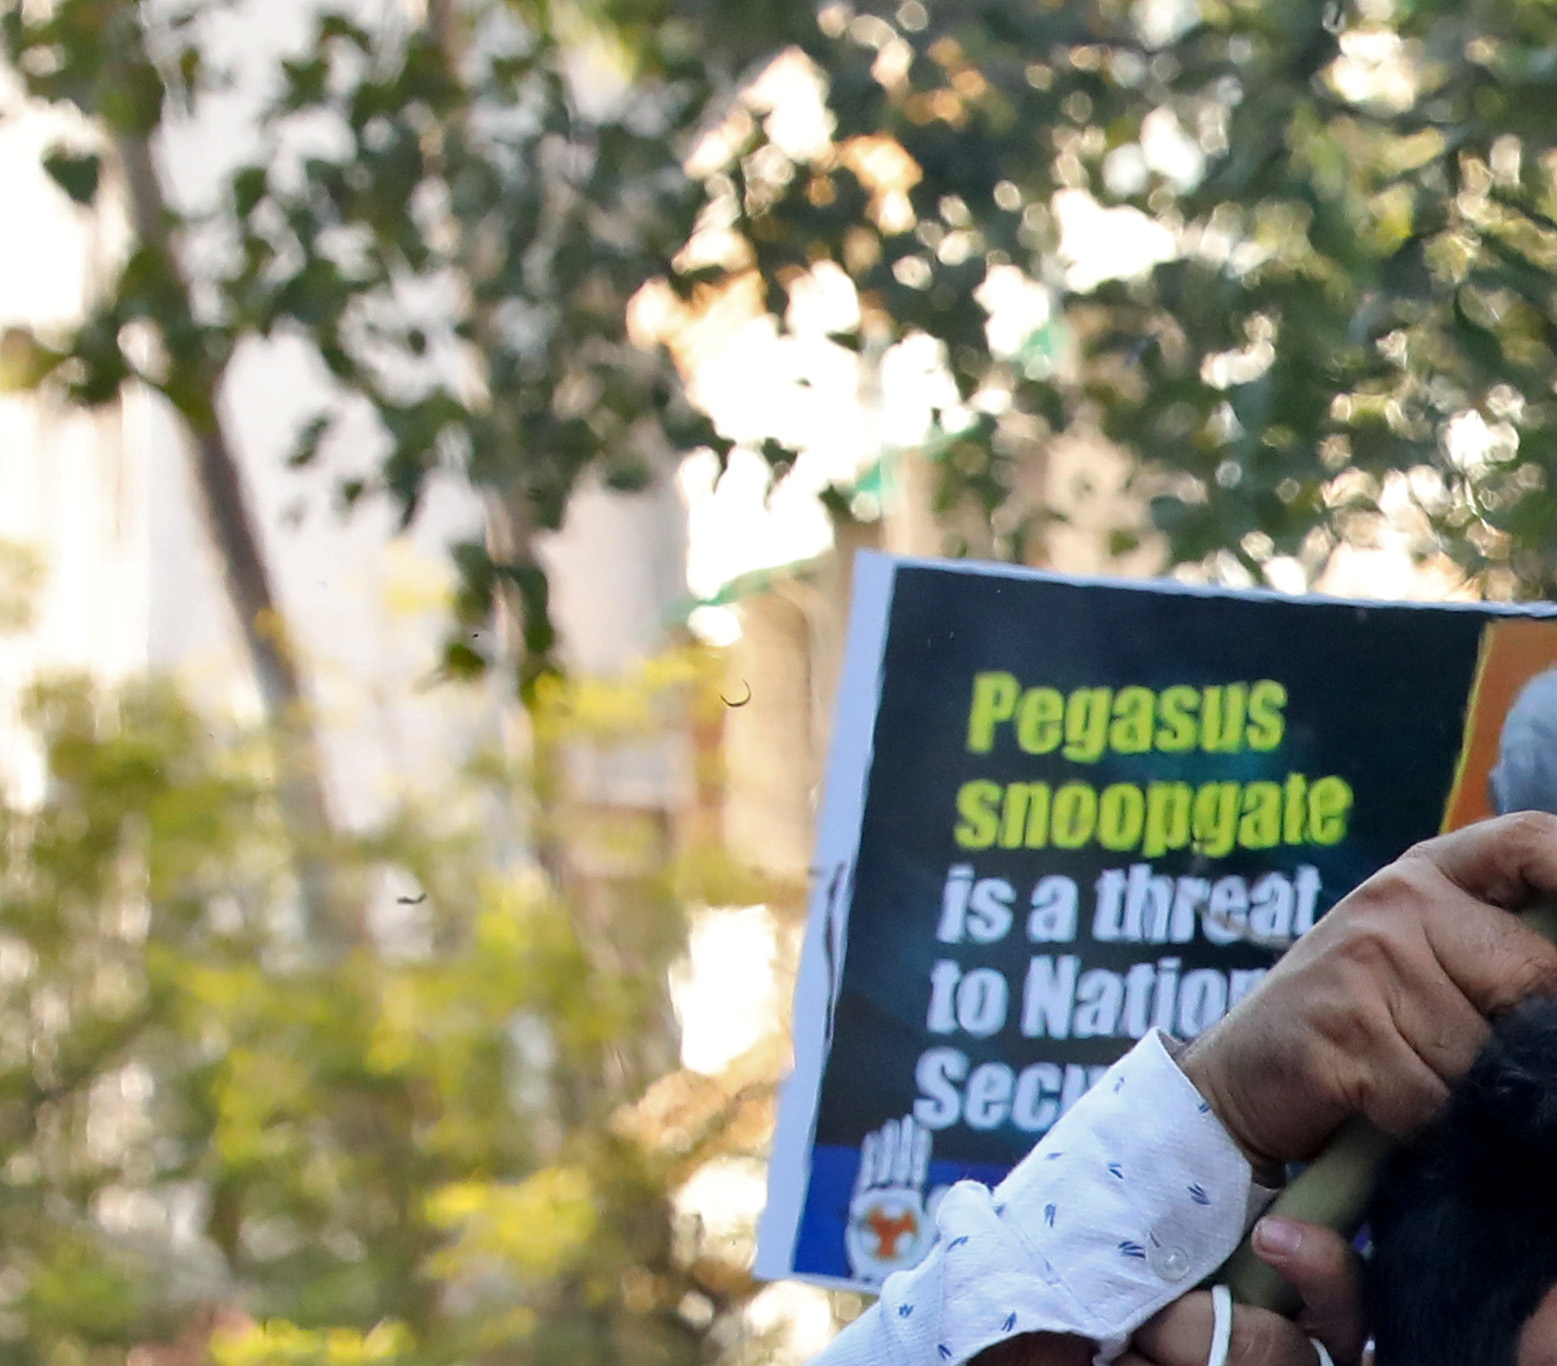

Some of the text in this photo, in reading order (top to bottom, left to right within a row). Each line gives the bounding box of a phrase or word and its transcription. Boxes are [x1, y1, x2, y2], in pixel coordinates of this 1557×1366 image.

[971, 675, 1285, 757] Pegasus
[957, 775, 1350, 855] snoopgate
[937, 864, 1322, 945] is a threat
[927, 961, 1005, 1035] to
